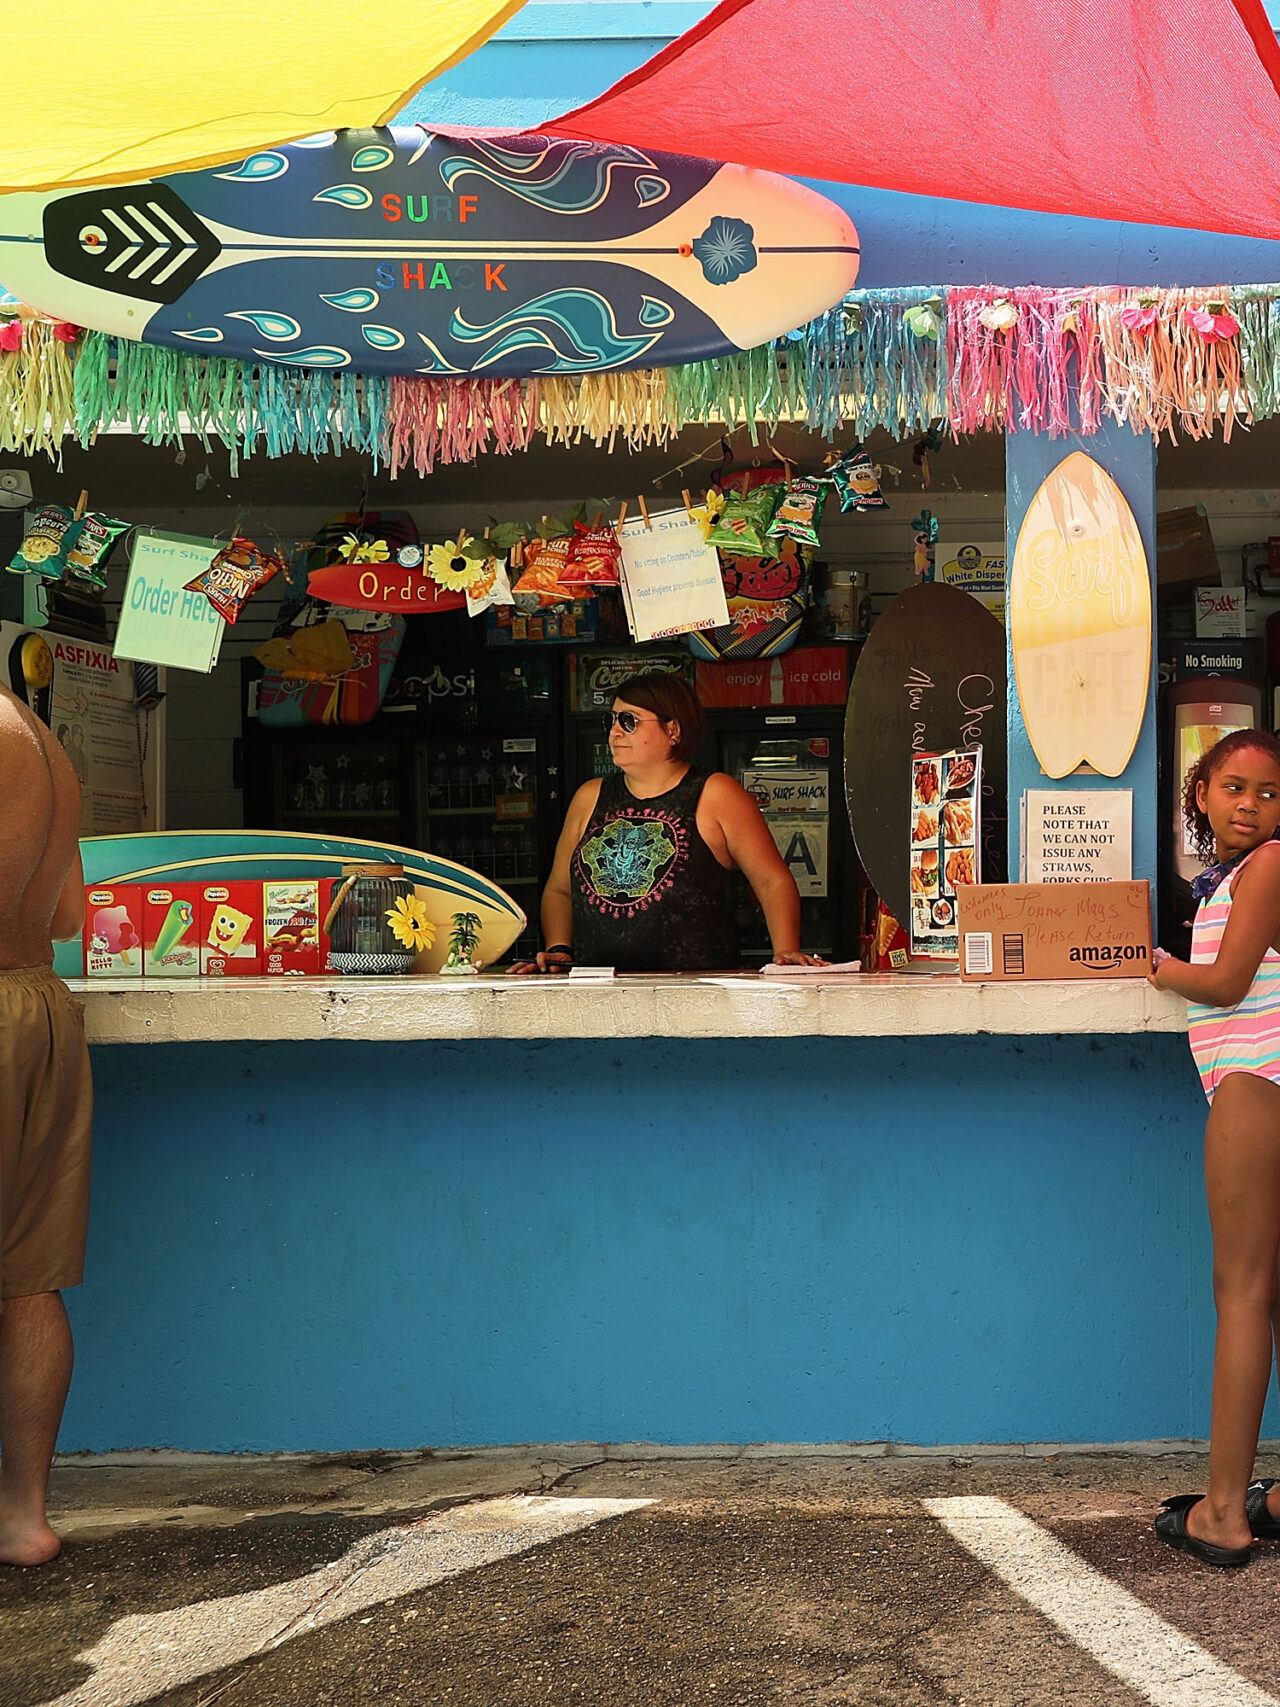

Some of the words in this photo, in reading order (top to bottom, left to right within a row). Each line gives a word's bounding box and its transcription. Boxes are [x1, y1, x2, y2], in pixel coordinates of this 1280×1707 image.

[381, 193, 479, 223] SURF
[376, 262, 507, 291] SHACK
[620, 527, 655, 539] Surf
[658, 521, 700, 531] Shac
[141, 543, 176, 556] Surf
[209, 568, 250, 600] NACHO
[946, 571, 973, 584] White
[1023, 526, 1136, 626] Surf
[359, 571, 445, 602] Order
[636, 587, 651, 597] Good
[130, 576, 179, 616] Order
[180, 590, 217, 624] Here
[54, 642, 120, 673] ASFIXIA
[1185, 655, 1199, 667] No
[1201, 654, 1243, 669] Smoking
[726, 672, 763, 686] enjoy
[790, 670, 809, 682] ice
[812, 670, 841, 681] cold
[772, 786, 795, 801] SURF
[797, 785, 827, 799] SHACK
[1043, 805, 1086, 815] PLEASE
[1043, 820, 1075, 830] NOTE
[1077, 820, 1110, 830] THAT
[1043, 834, 1062, 844] WE
[1064, 834, 1088, 844] CAN
[1090, 834, 1116, 844] NOT
[784, 832, 818, 876] A
[1043, 848, 1075, 858] ISSUE
[1077, 848, 1102, 858] ANY
[1042, 862, 1095, 874] STRAWS,
[975, 902, 1003, 922] only
[265, 918, 288, 926] FROZEN
[1084, 923, 1136, 944] Return
[1069, 944, 1147, 961] amazon
[90, 957, 113, 965] HELLO
[91, 963, 113, 971] KITTY
